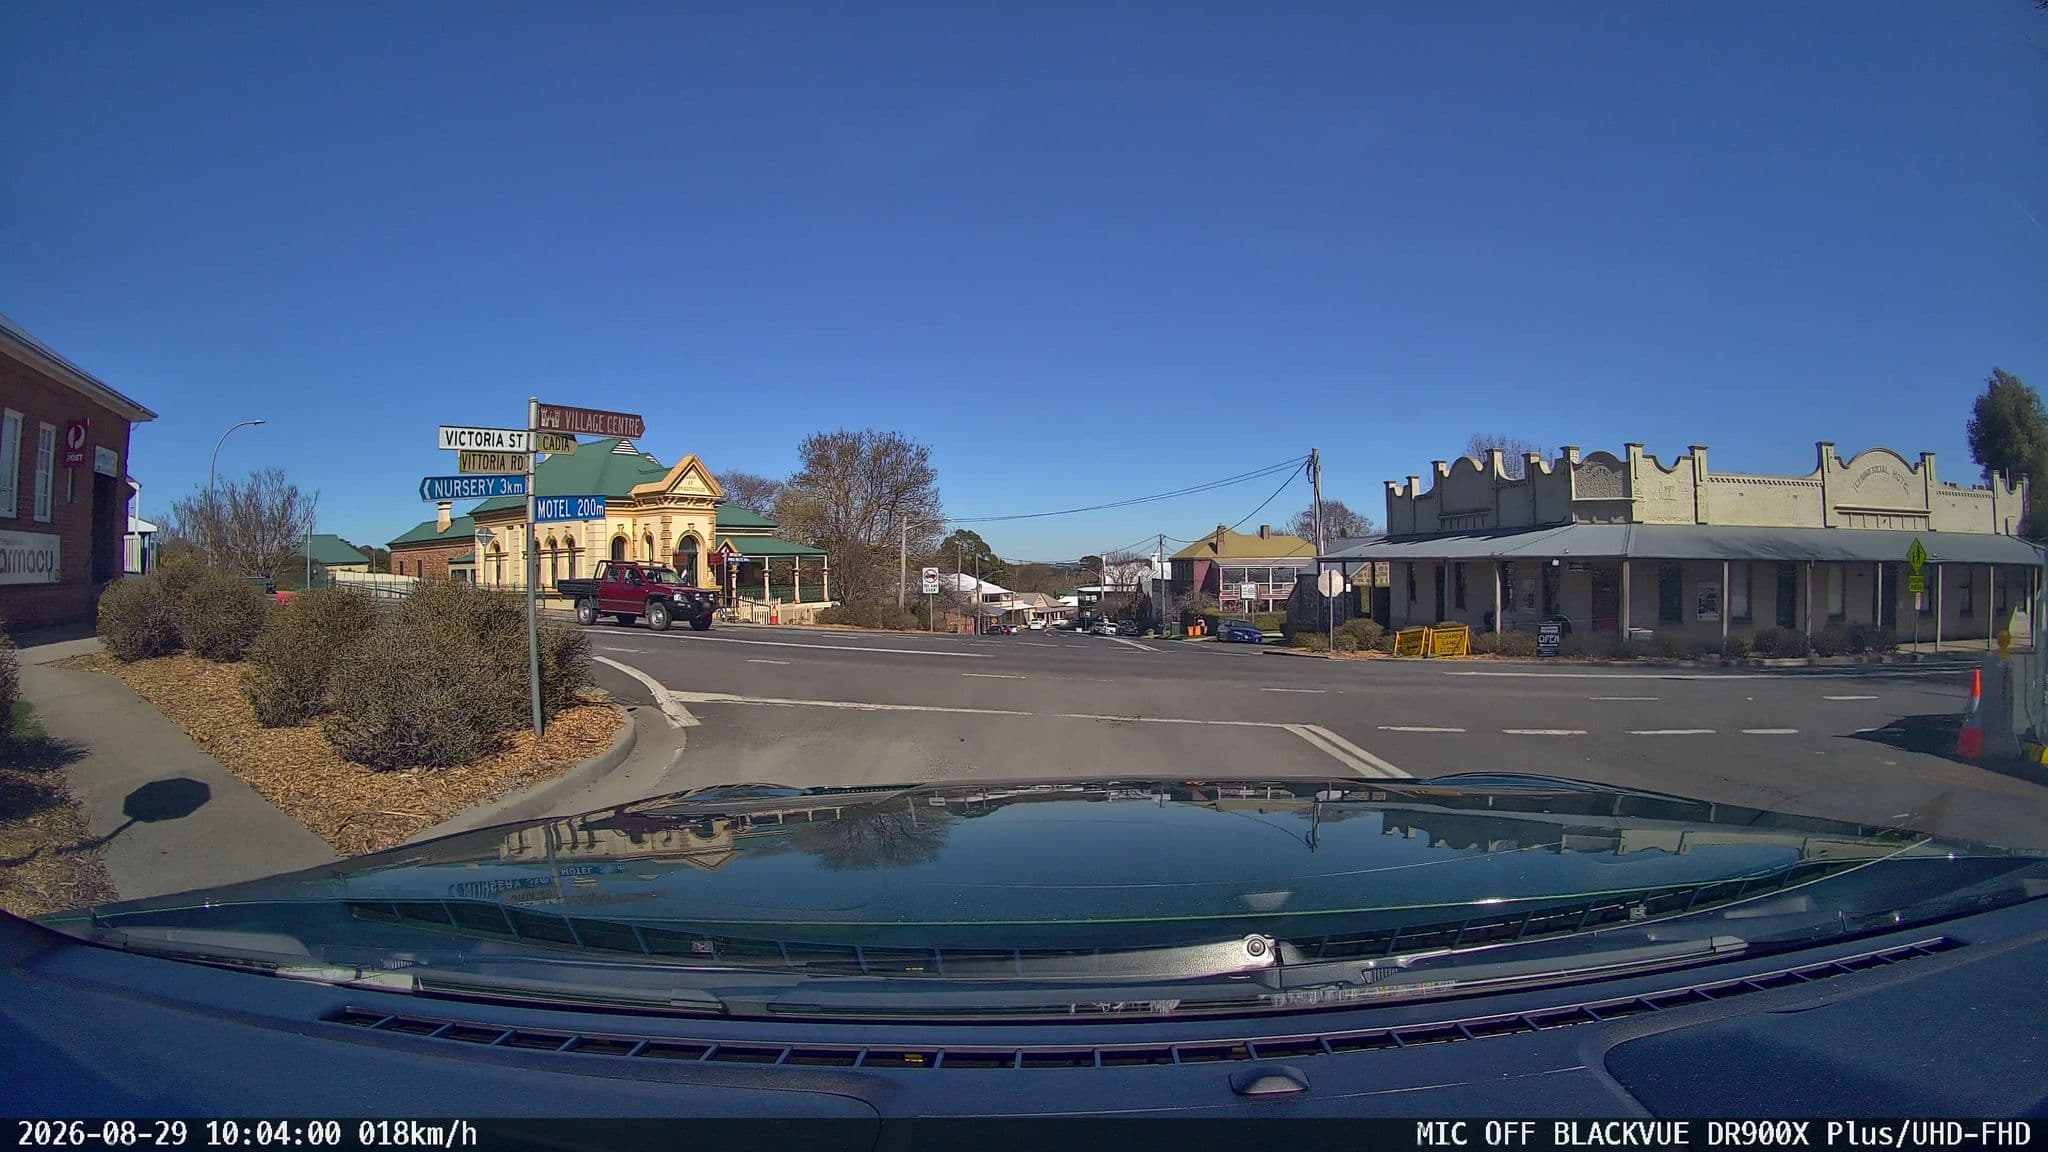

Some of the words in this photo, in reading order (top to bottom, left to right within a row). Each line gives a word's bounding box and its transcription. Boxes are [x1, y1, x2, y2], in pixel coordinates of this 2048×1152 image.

[565, 410, 604, 432] VILLAGE
[607, 416, 640, 436] CENTRE
[446, 430, 504, 447] VICTORIA
[509, 433, 523, 448] ST
[543, 436, 570, 451] CADIA
[462, 454, 505, 470] VITTORIA
[510, 455, 523, 471] RD
[435, 478, 495, 497] NURSERY
[500, 478, 523, 494] 3km
[537, 500, 571, 518] MOTEL
[577, 499, 604, 516] 200m
[1538, 634, 1560, 644] OPEN
